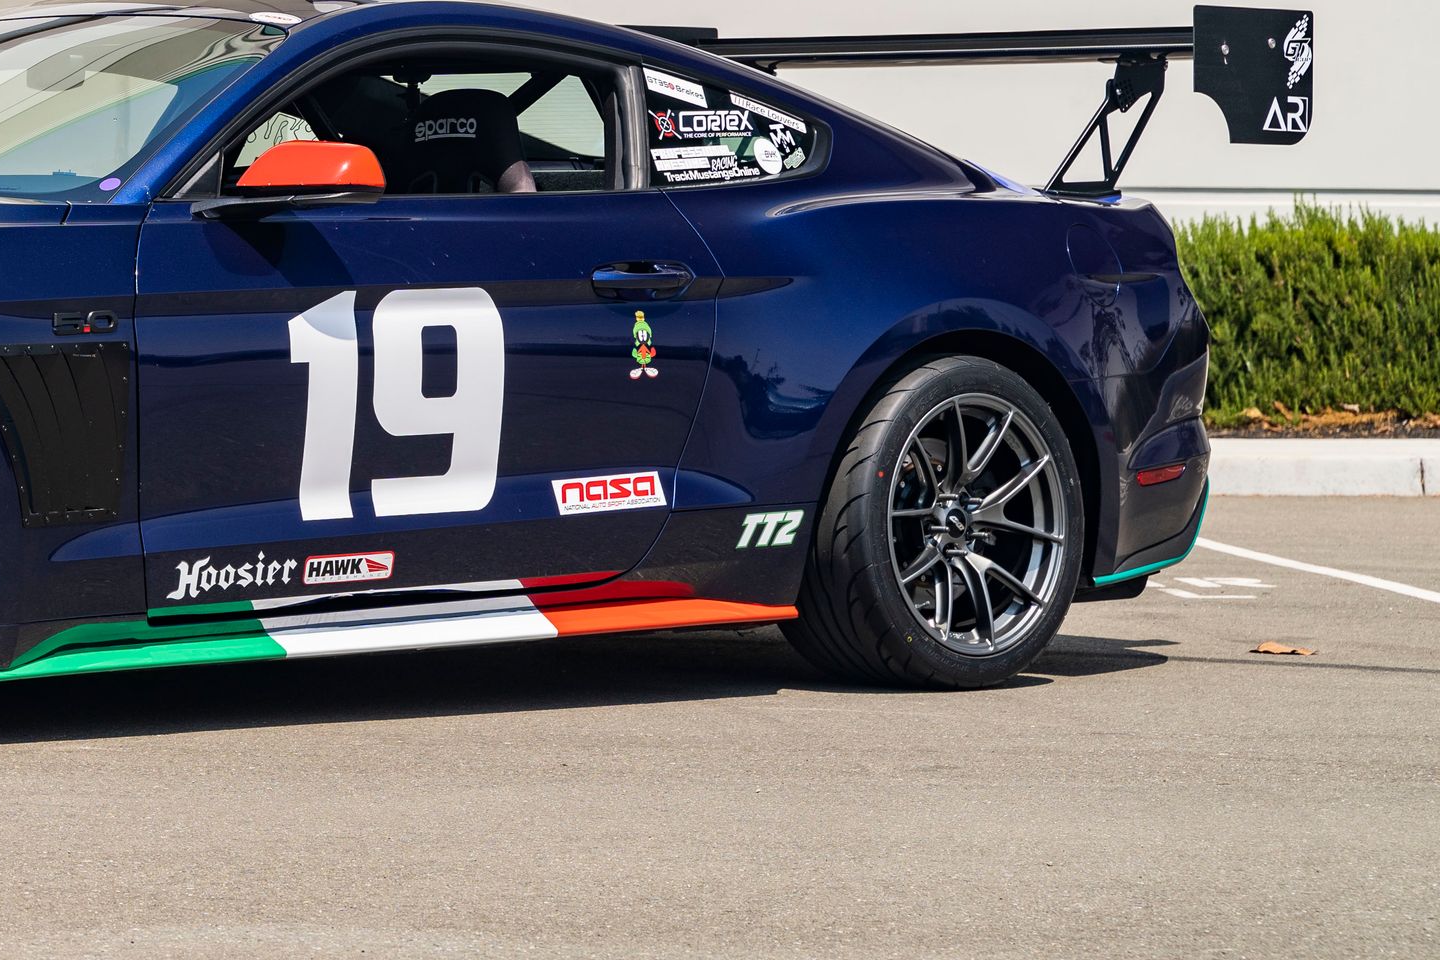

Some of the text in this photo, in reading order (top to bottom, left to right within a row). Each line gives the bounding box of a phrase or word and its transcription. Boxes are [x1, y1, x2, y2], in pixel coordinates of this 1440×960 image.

[414, 117, 477, 139] sparco
[664, 166, 760, 182] TrackMustangsOnline
[711, 155, 738, 171] RACING
[52, 310, 119, 336] 5.0
[288, 287, 505, 521] 19
[563, 503, 590, 511] NATIONAL
[591, 501, 607, 509] AUTO
[626, 497, 661, 506] ASSOCIATION
[736, 509, 805, 549] TT2
[166, 550, 297, 599] Hoosier
[307, 557, 364, 578] HAWK
